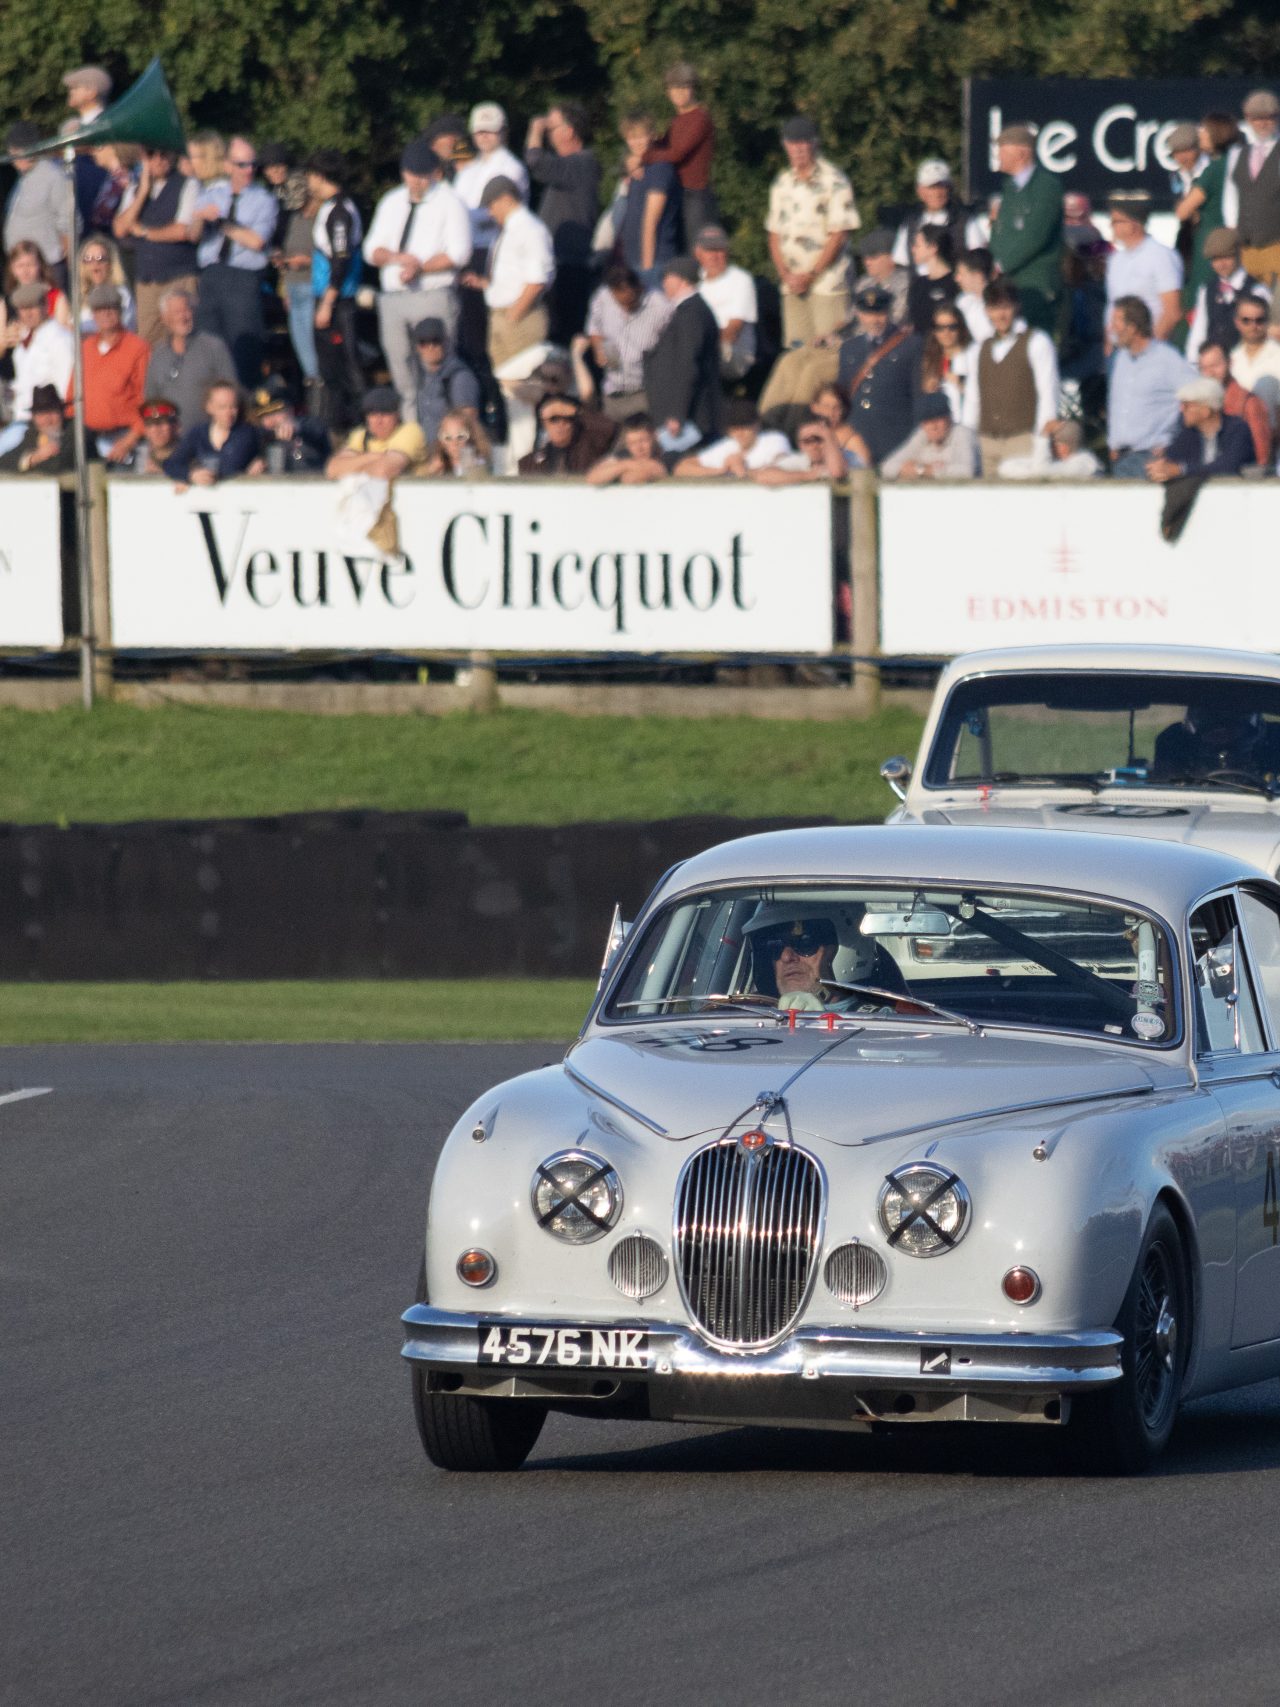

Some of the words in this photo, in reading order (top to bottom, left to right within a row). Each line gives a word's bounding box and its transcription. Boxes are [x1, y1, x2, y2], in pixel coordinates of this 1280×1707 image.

[988, 107, 1078, 174] Ie
[194, 510, 417, 609] Veuve
[439, 510, 757, 634] Clicquot
[966, 595, 1169, 620] EDMISTON
[482, 1326, 581, 1366] 4576
[591, 1329, 647, 1368] NK
